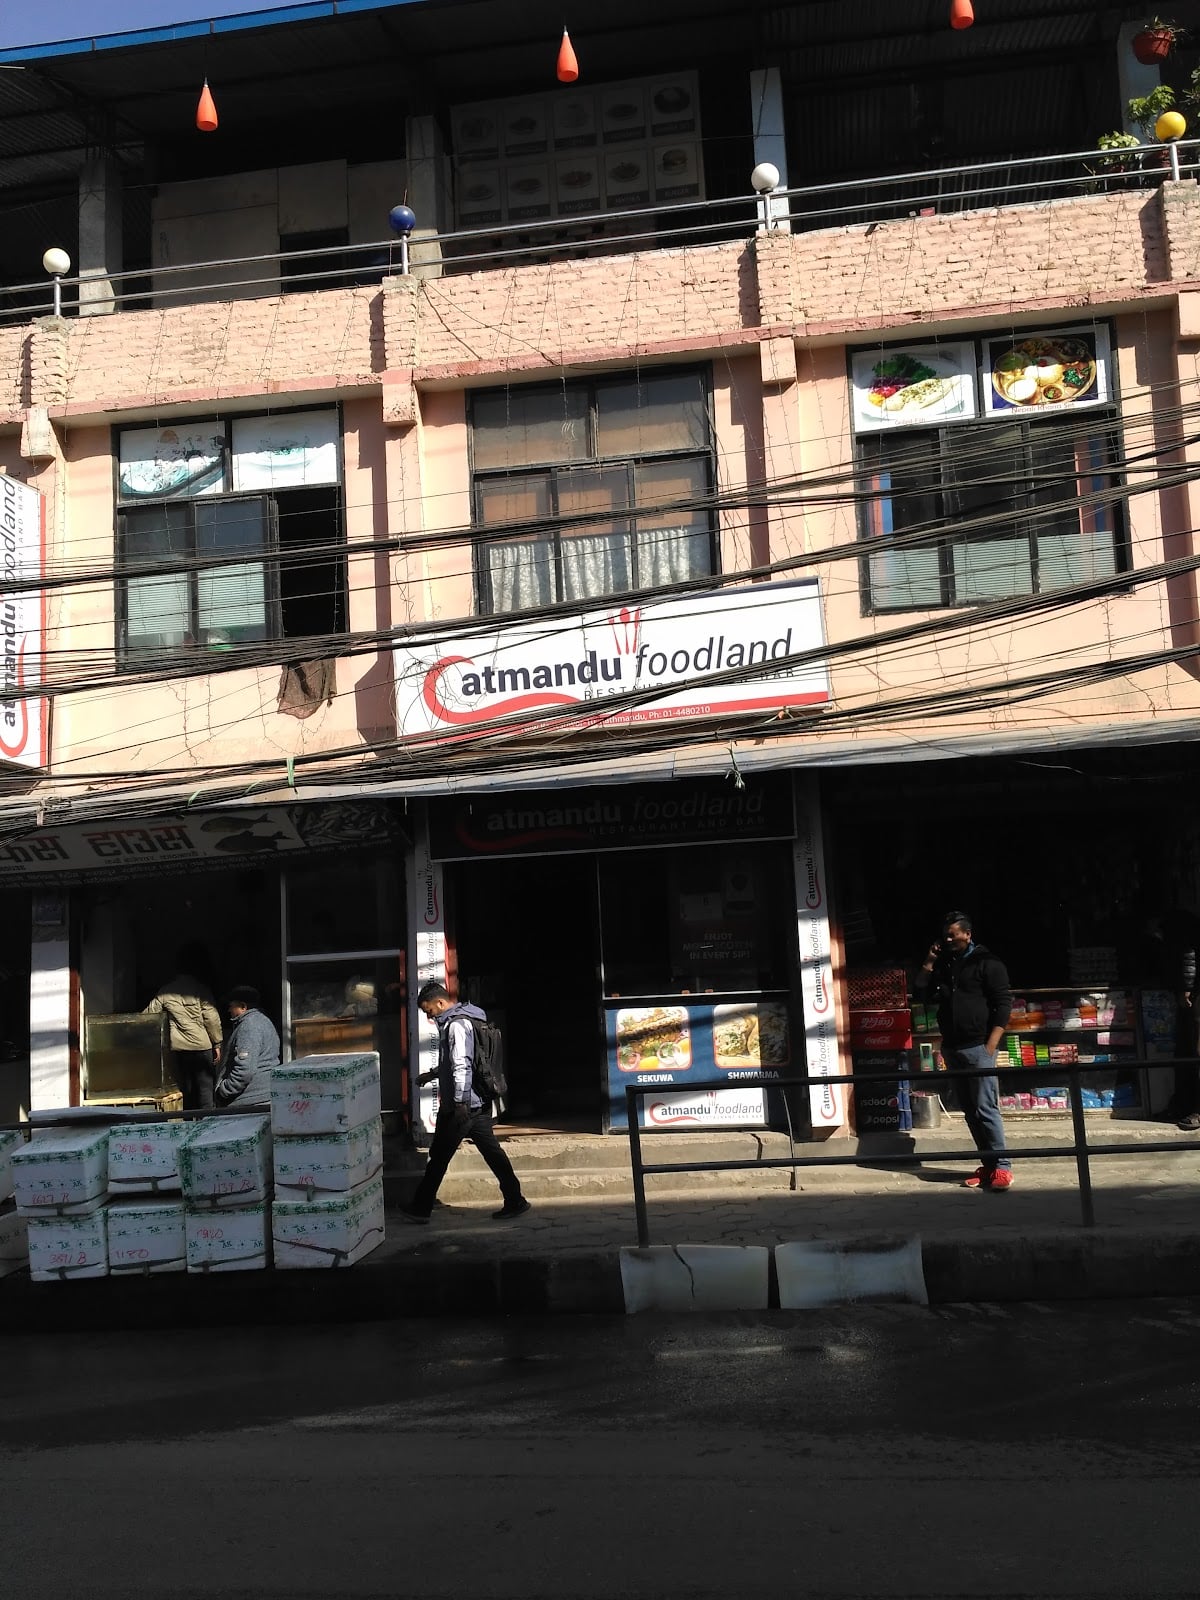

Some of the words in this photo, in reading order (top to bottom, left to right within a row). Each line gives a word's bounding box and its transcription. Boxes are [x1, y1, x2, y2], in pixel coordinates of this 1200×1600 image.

[636, 628, 793, 678] foodland
[648, 709, 662, 720] Ph:
[663, 704, 711, 718] 01-4480210
[637, 1073, 674, 1083] SEKUWA
[727, 1070, 779, 1080] SHAWARMA
[714, 1102, 763, 1115] foodland
